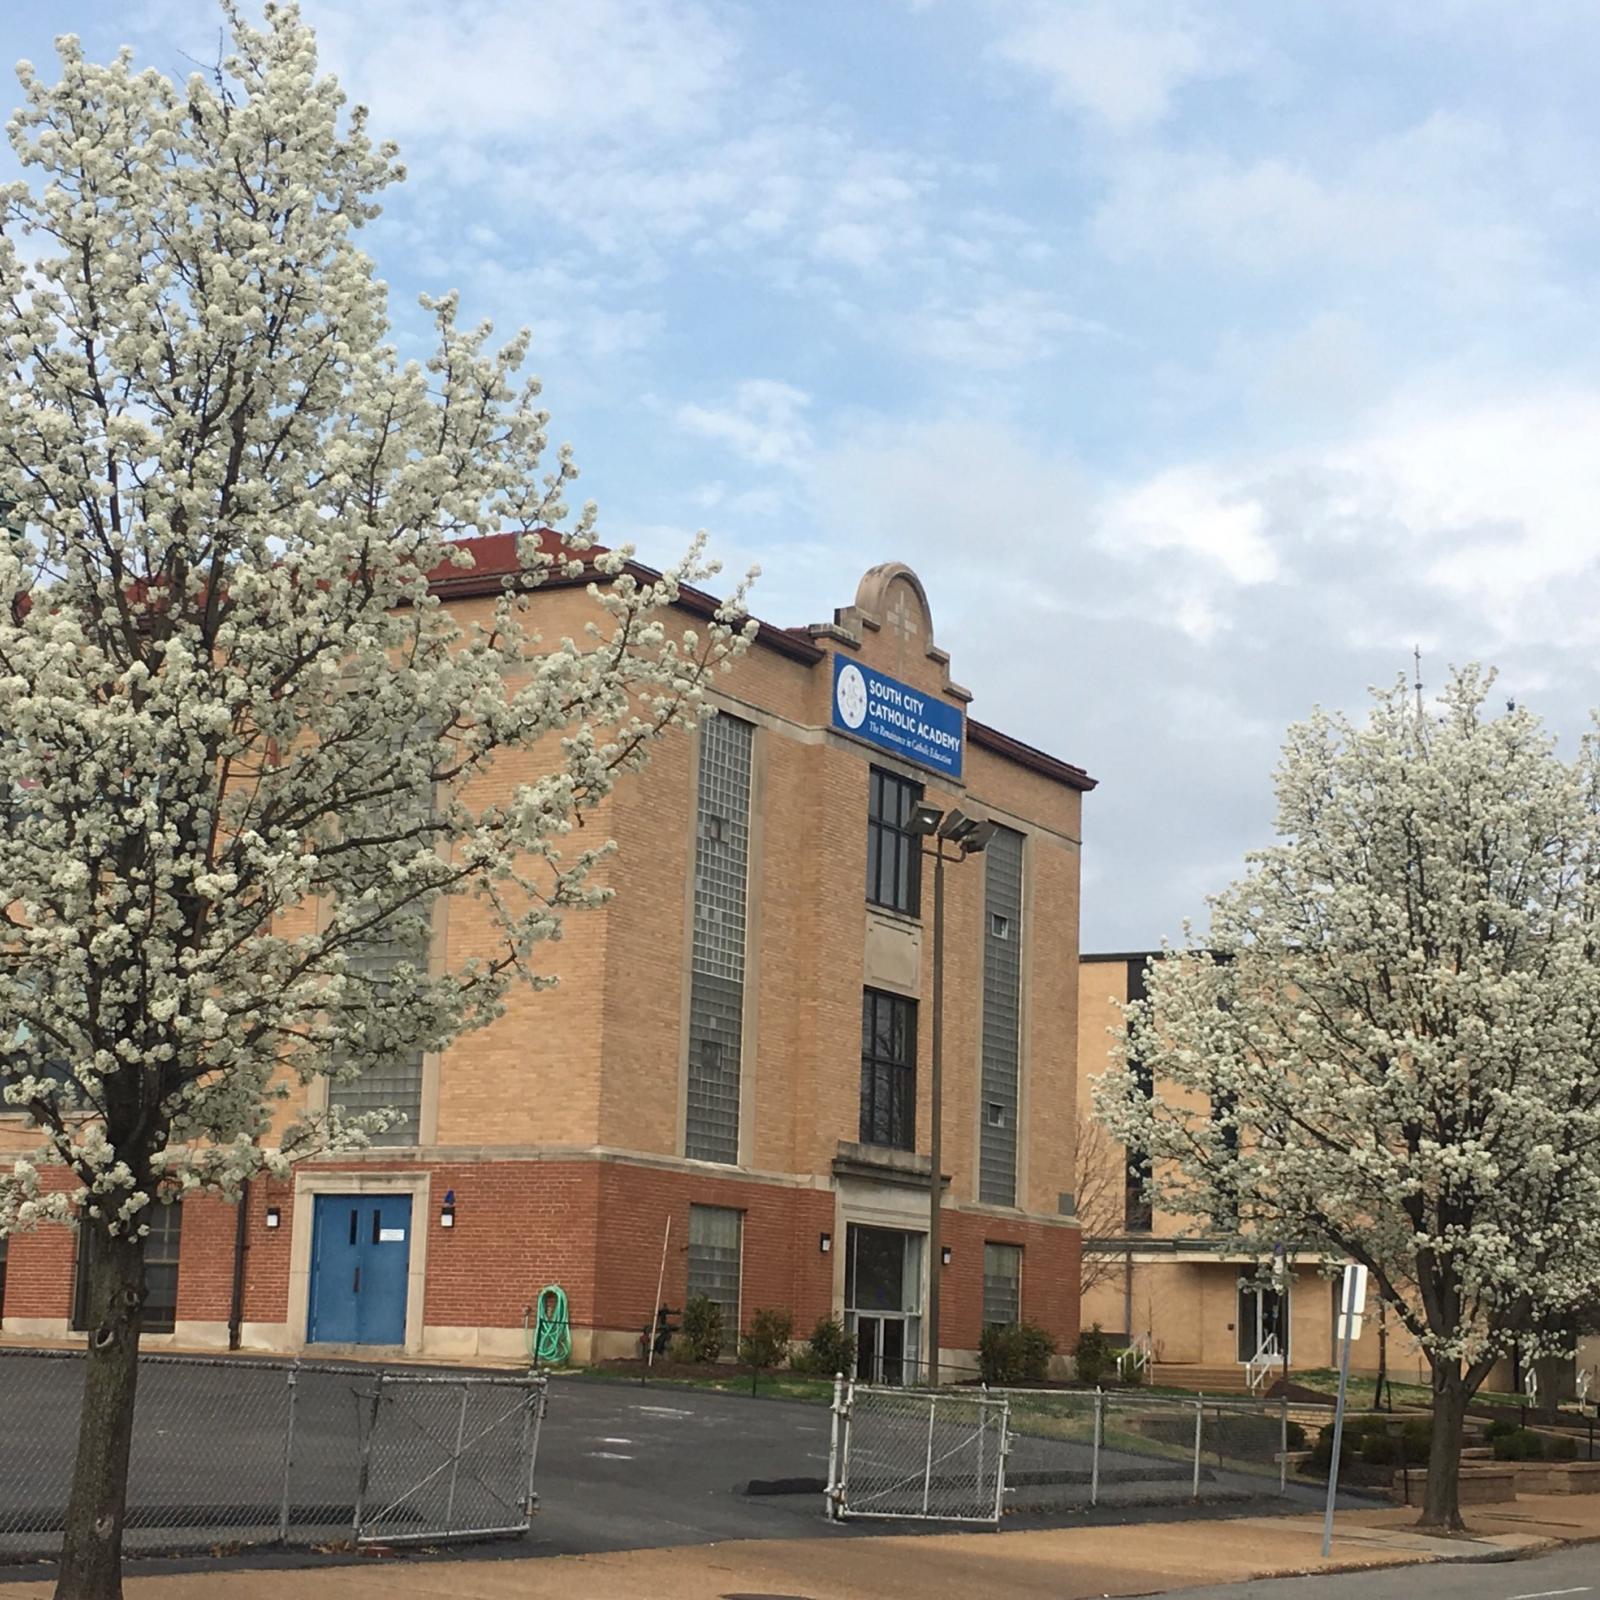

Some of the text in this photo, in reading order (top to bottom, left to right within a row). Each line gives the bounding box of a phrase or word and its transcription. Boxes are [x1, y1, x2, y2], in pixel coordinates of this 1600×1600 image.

[869, 680, 925, 717] SOUTH CITY
[868, 701, 960, 752] CATHOLIC ACADEMY
[868, 721, 879, 735] The
